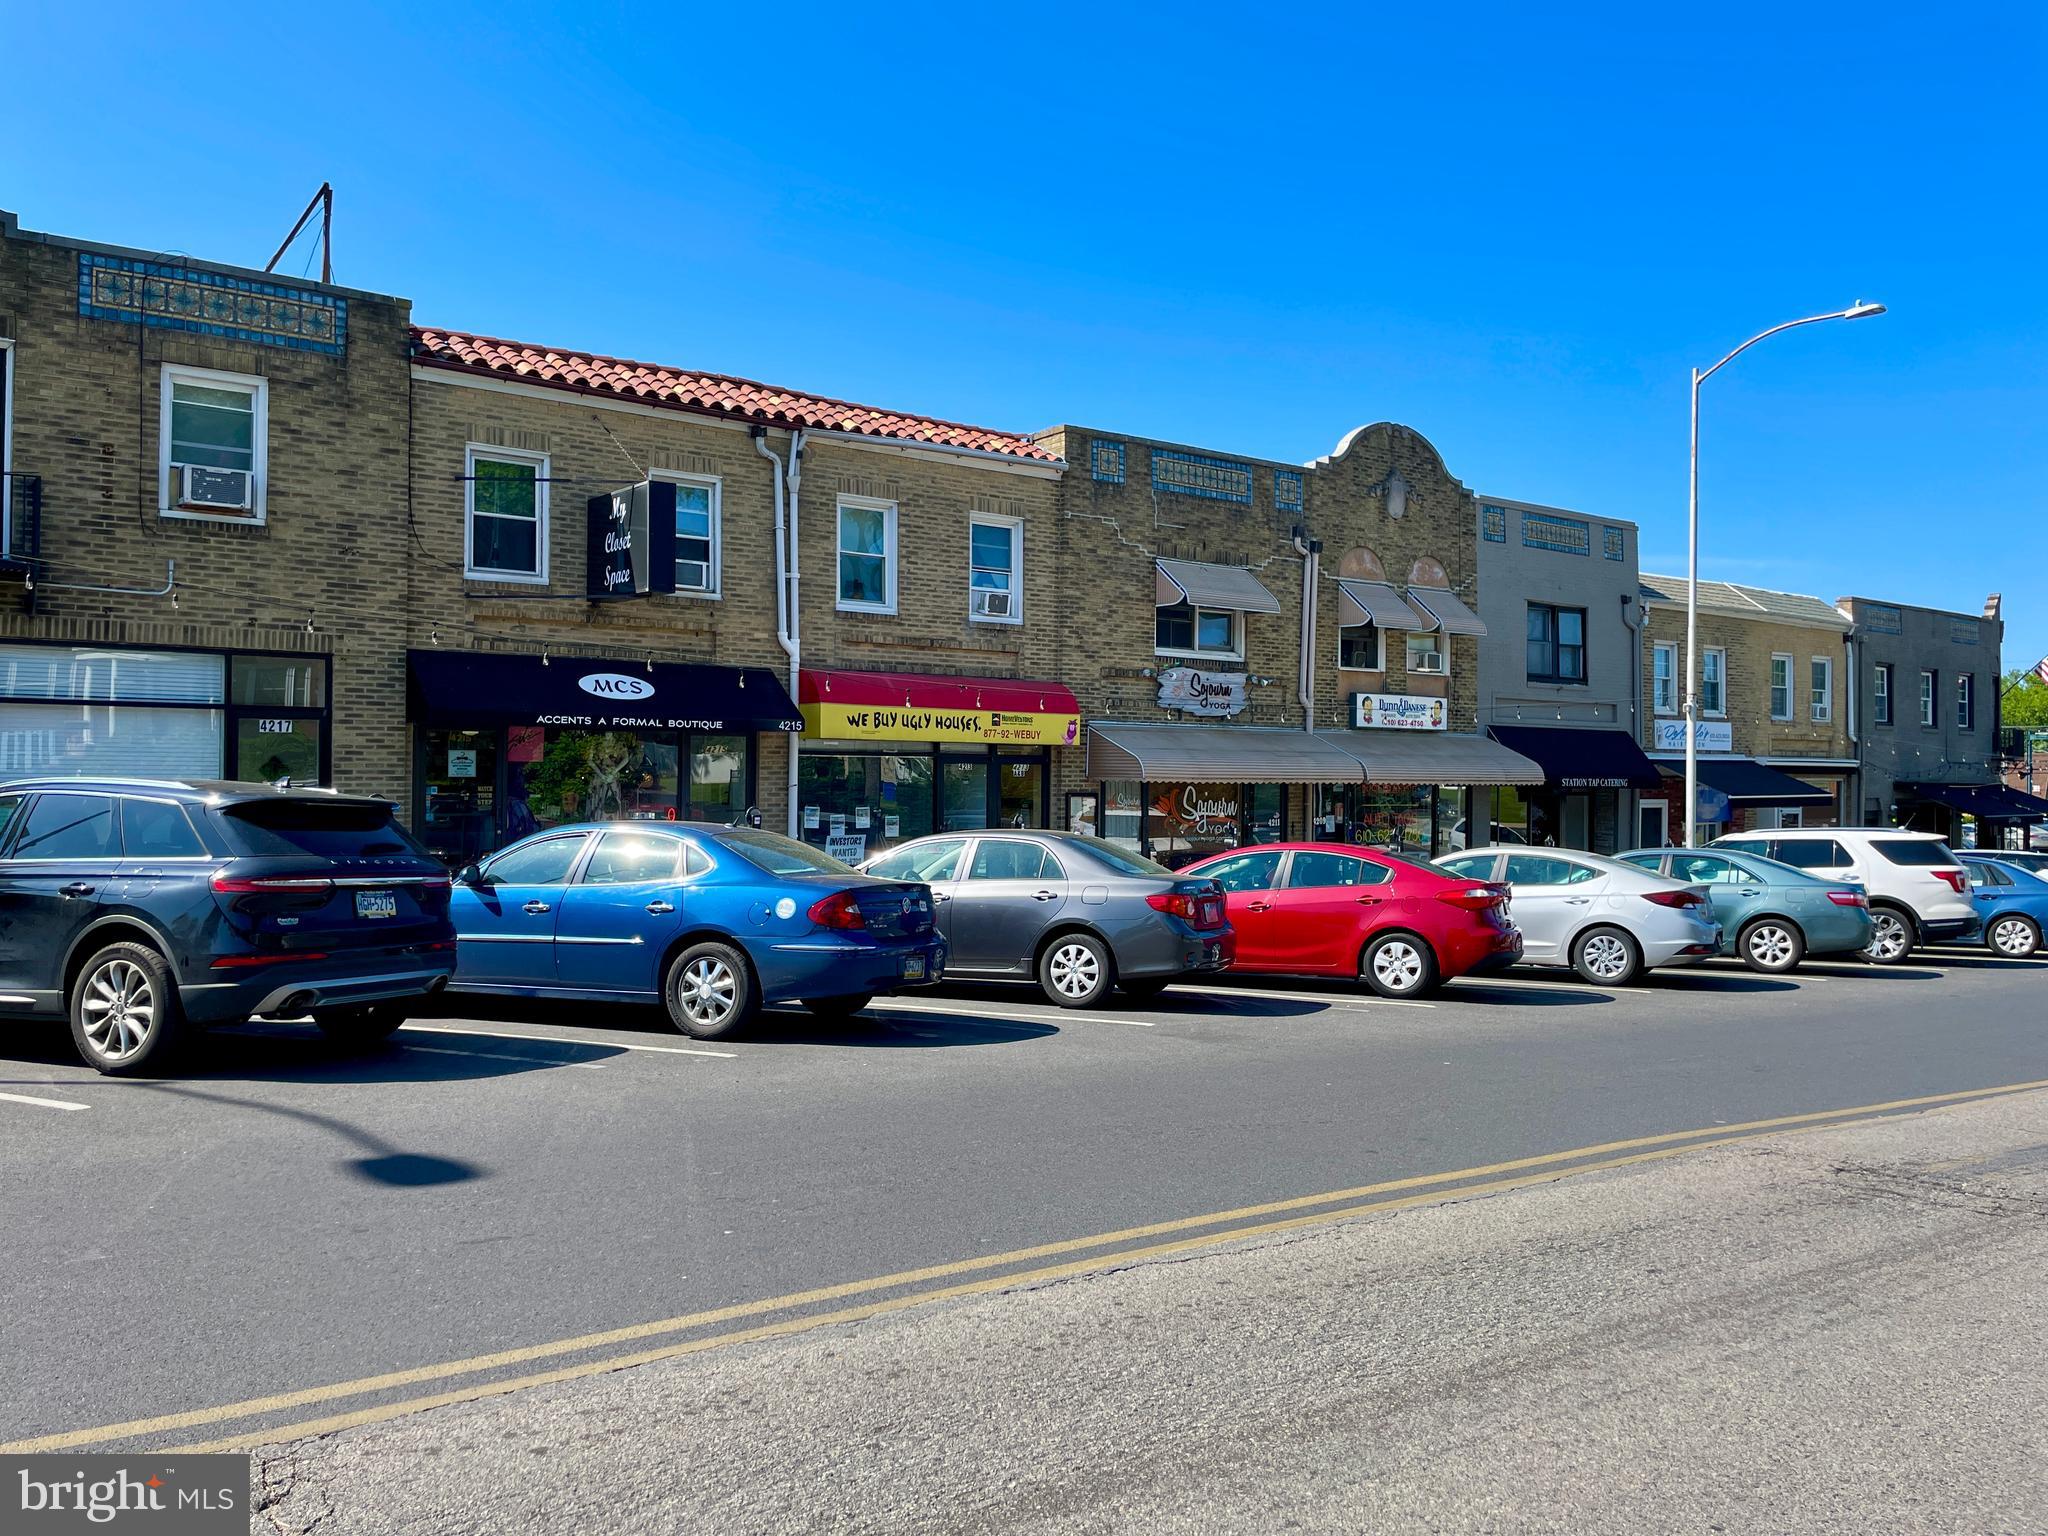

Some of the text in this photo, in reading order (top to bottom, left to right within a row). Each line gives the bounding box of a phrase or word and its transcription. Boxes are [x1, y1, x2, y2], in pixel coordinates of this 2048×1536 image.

[609, 496, 627, 524] My
[604, 531, 632, 554] Closet
[604, 565, 630, 592] Space
[592, 679, 643, 694] MCS
[1189, 673, 1233, 708] Sojourn
[1209, 702, 1231, 710] YOGA
[260, 720, 292, 732] 4217
[536, 715, 723, 730] ACCENTS A FORMAL BOUTIQUE
[778, 720, 802, 731] 4215
[847, 712, 982, 732] WE BUY UGLY HOUSES.
[983, 729, 1041, 740] 877-92-WEBUY
[1561, 778, 1629, 787] STATION TAP CATERING
[1182, 785, 1239, 834] Sojourn
[831, 847, 858, 857] WANTED
